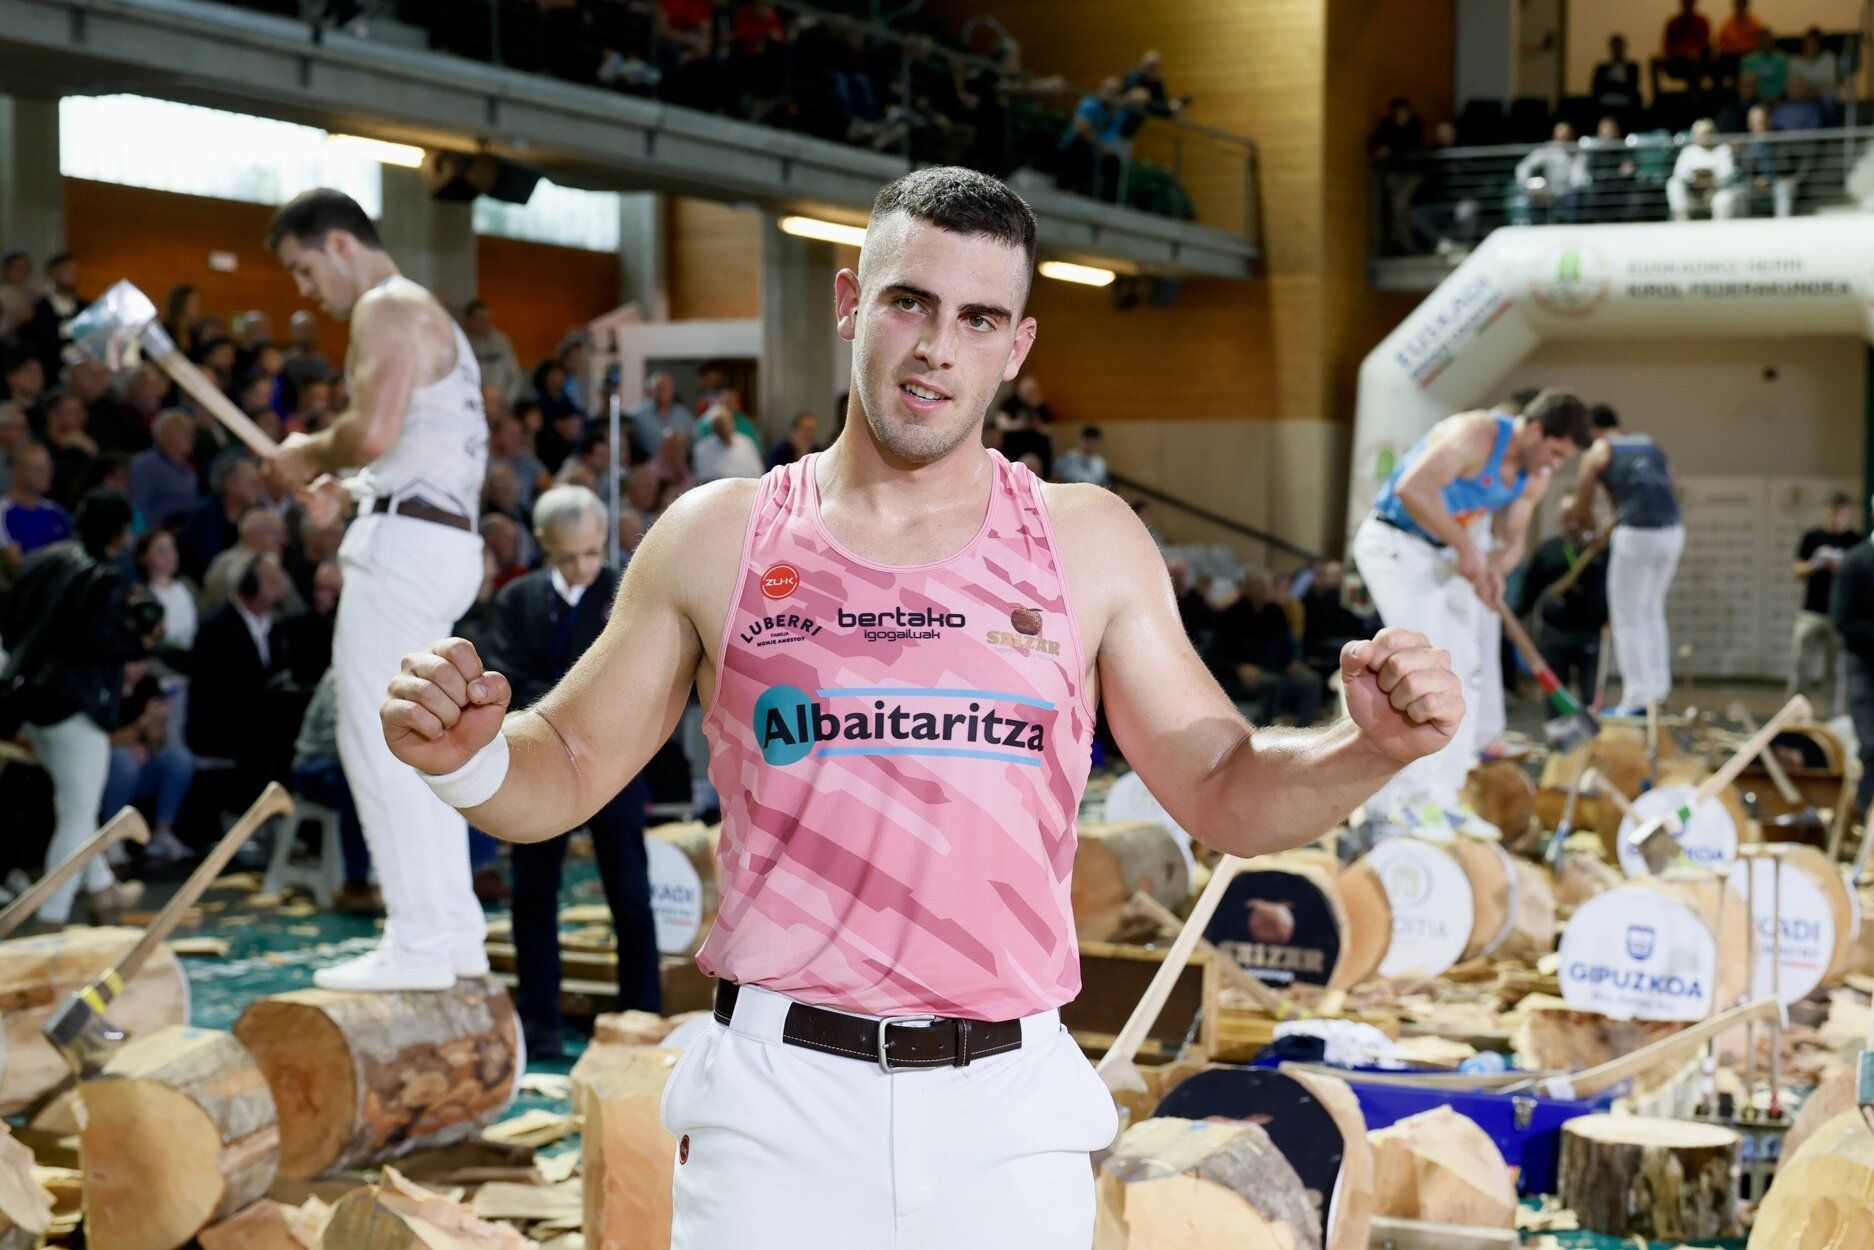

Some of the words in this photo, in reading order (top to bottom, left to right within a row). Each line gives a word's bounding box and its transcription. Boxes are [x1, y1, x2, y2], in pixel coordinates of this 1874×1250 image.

[740, 614, 822, 644] LUBERRI
[838, 606, 966, 628] bertako
[864, 629, 941, 642] igogailuak
[763, 700, 1045, 752] Albaitaritza
[1569, 962, 1704, 998] GIPUZKOA
